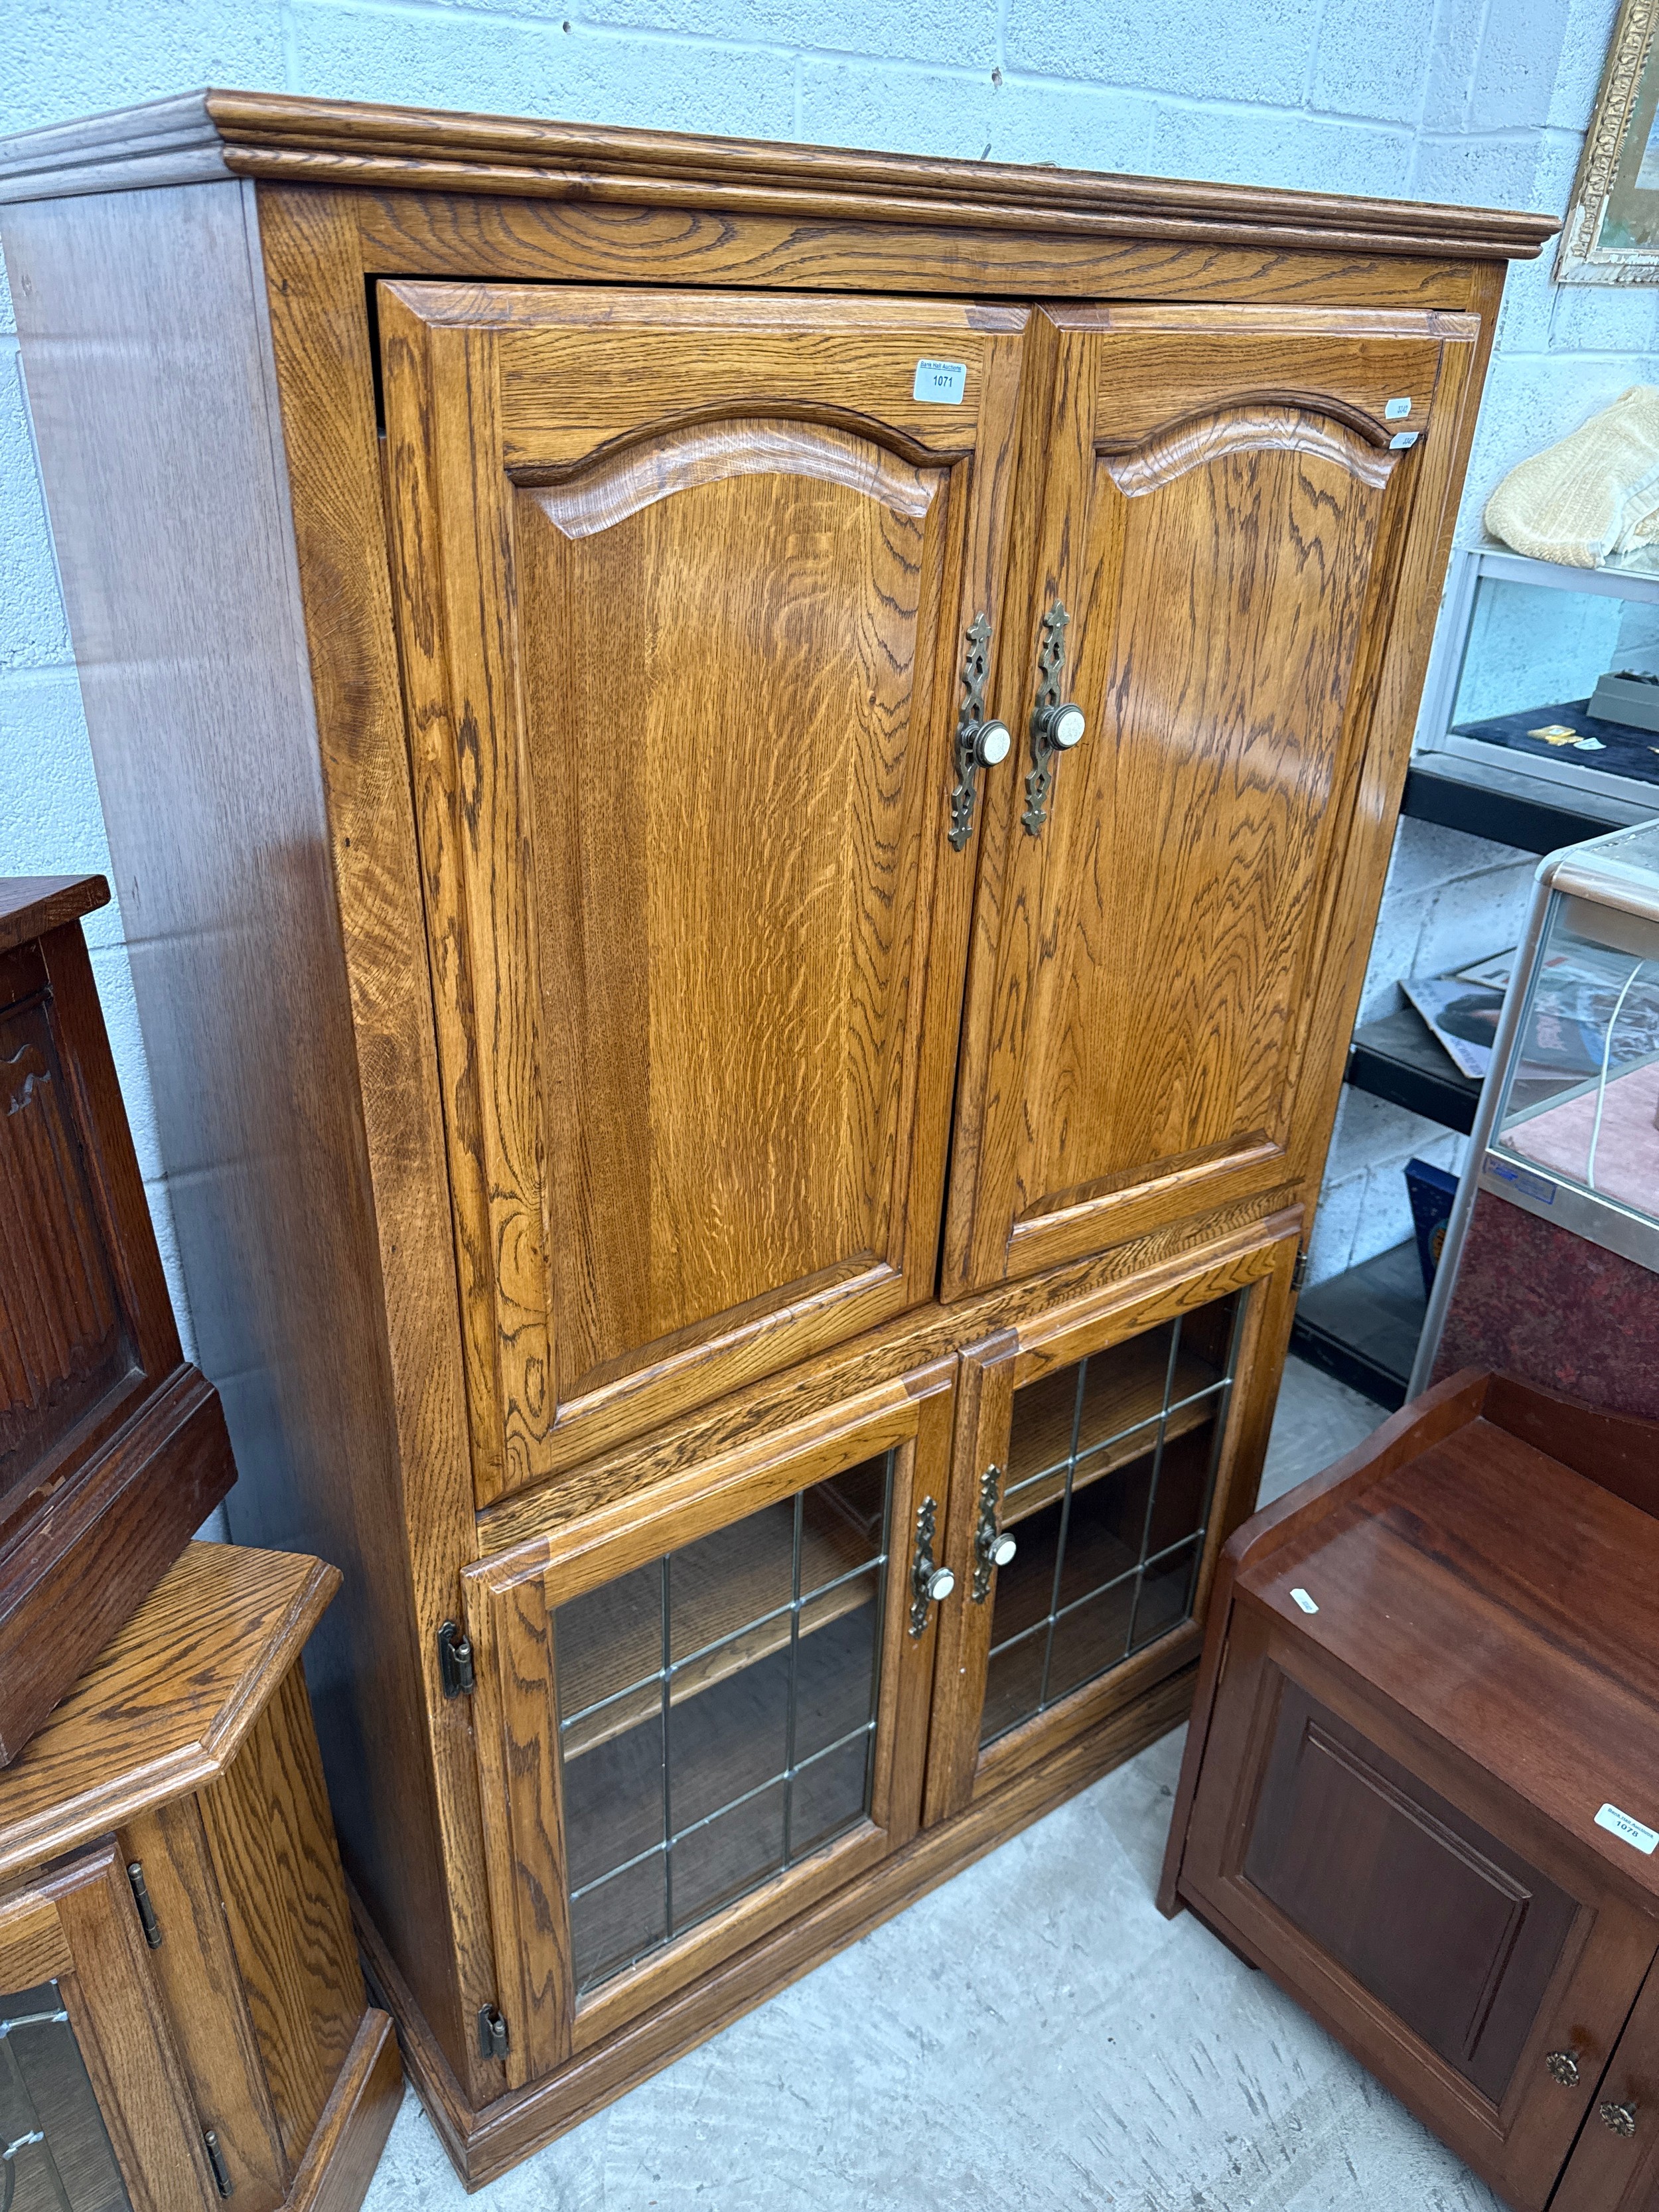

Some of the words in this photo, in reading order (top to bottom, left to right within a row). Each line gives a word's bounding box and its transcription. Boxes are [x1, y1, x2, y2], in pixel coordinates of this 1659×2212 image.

[934, 375, 953, 387] 1071
[1607, 1808, 1621, 1818] Bank
[1632, 1823, 1654, 1838] Auctions
[1616, 1820, 1639, 1837] 1078
